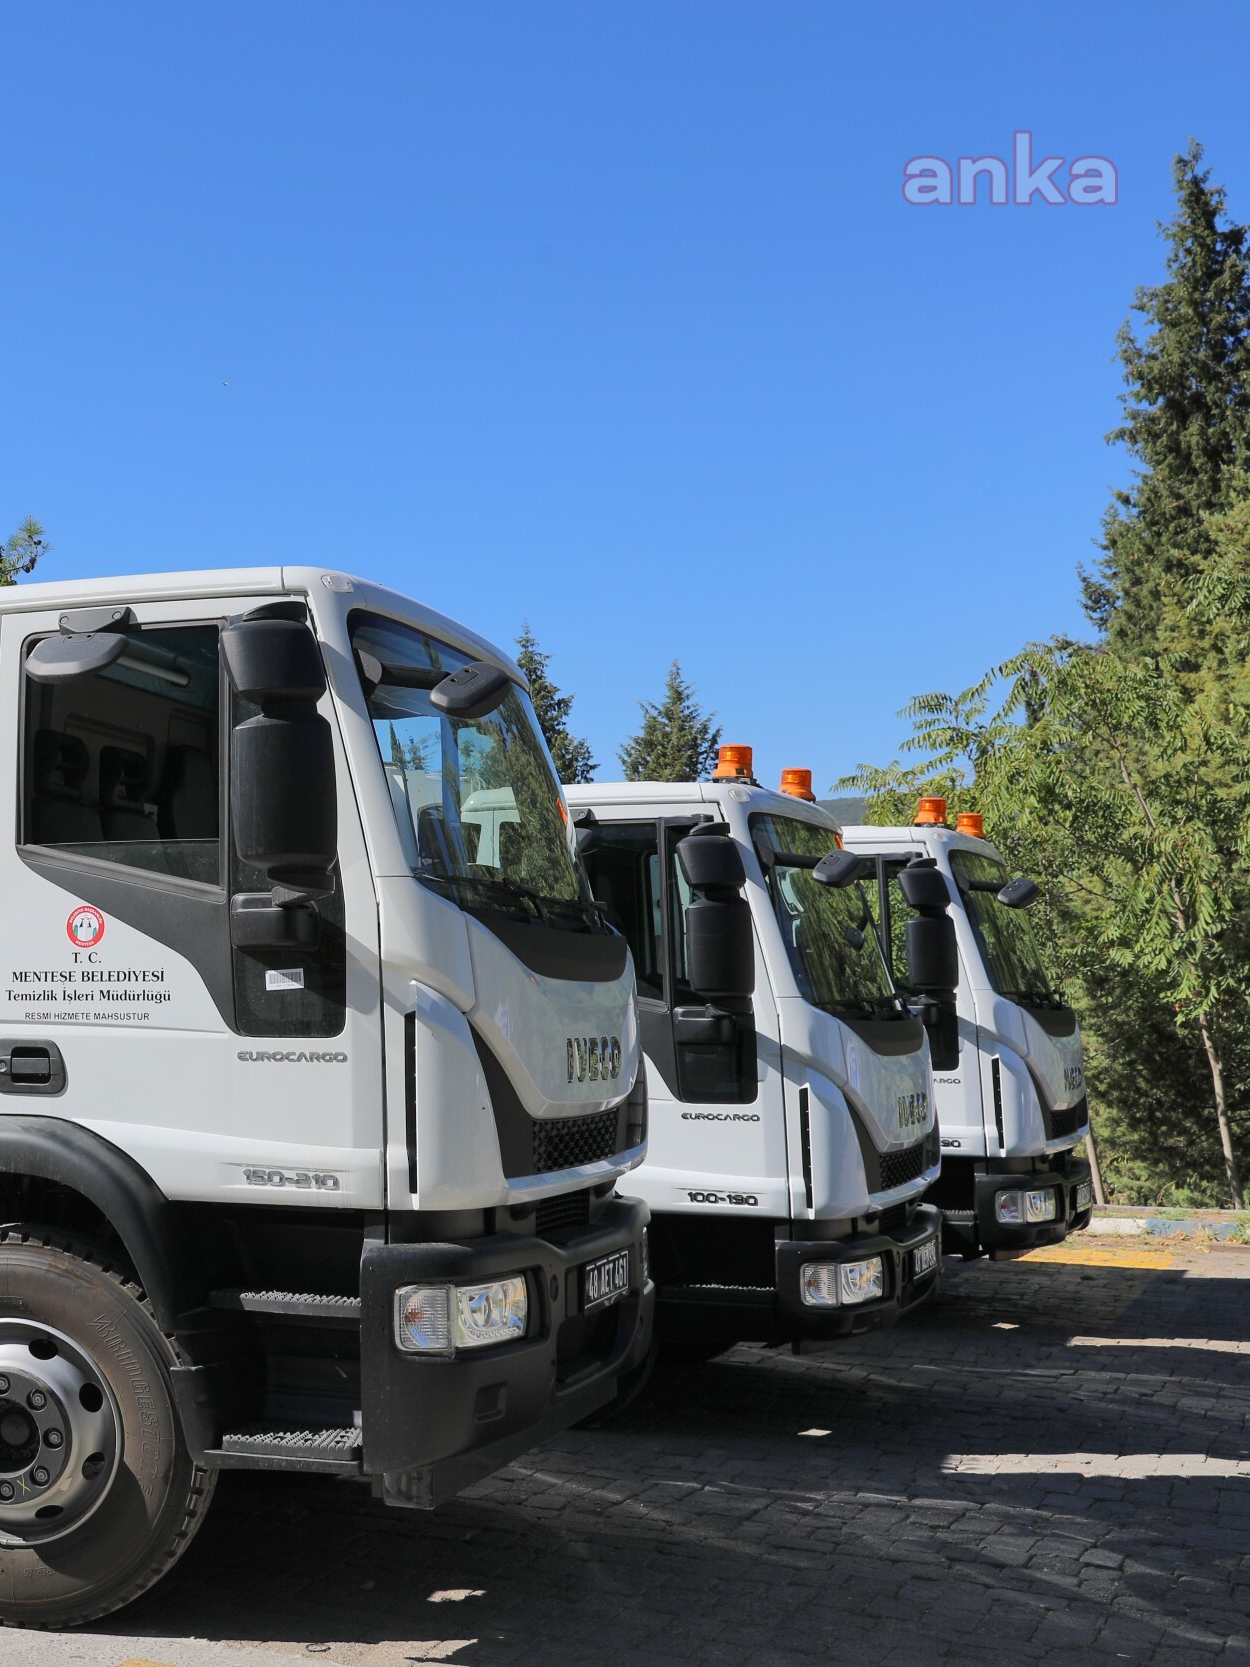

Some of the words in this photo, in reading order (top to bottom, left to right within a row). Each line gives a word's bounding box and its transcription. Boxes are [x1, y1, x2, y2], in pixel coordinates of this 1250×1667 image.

[71, 951, 83, 964] T.
[88, 951, 102, 964] C.
[12, 970, 77, 985] MENTEŞE
[81, 967, 165, 983] BELEDİYESİ
[5, 989, 58, 1002] Temizlik
[62, 986, 95, 1004] İşleri
[99, 989, 172, 1004] Müdürlüğü
[54, 1011, 91, 1021] HİZMETE
[93, 1011, 150, 1021] MAHSUSTUR
[237, 1050, 349, 1063] EUROCARGO
[566, 1036, 622, 1084] IVECO
[681, 1112, 761, 1122] EUROCARGO
[941, 1139, 962, 1148] 90
[242, 1168, 340, 1191] 150-210
[687, 1191, 759, 1206] 100-190
[589, 1269, 598, 1300] 48
